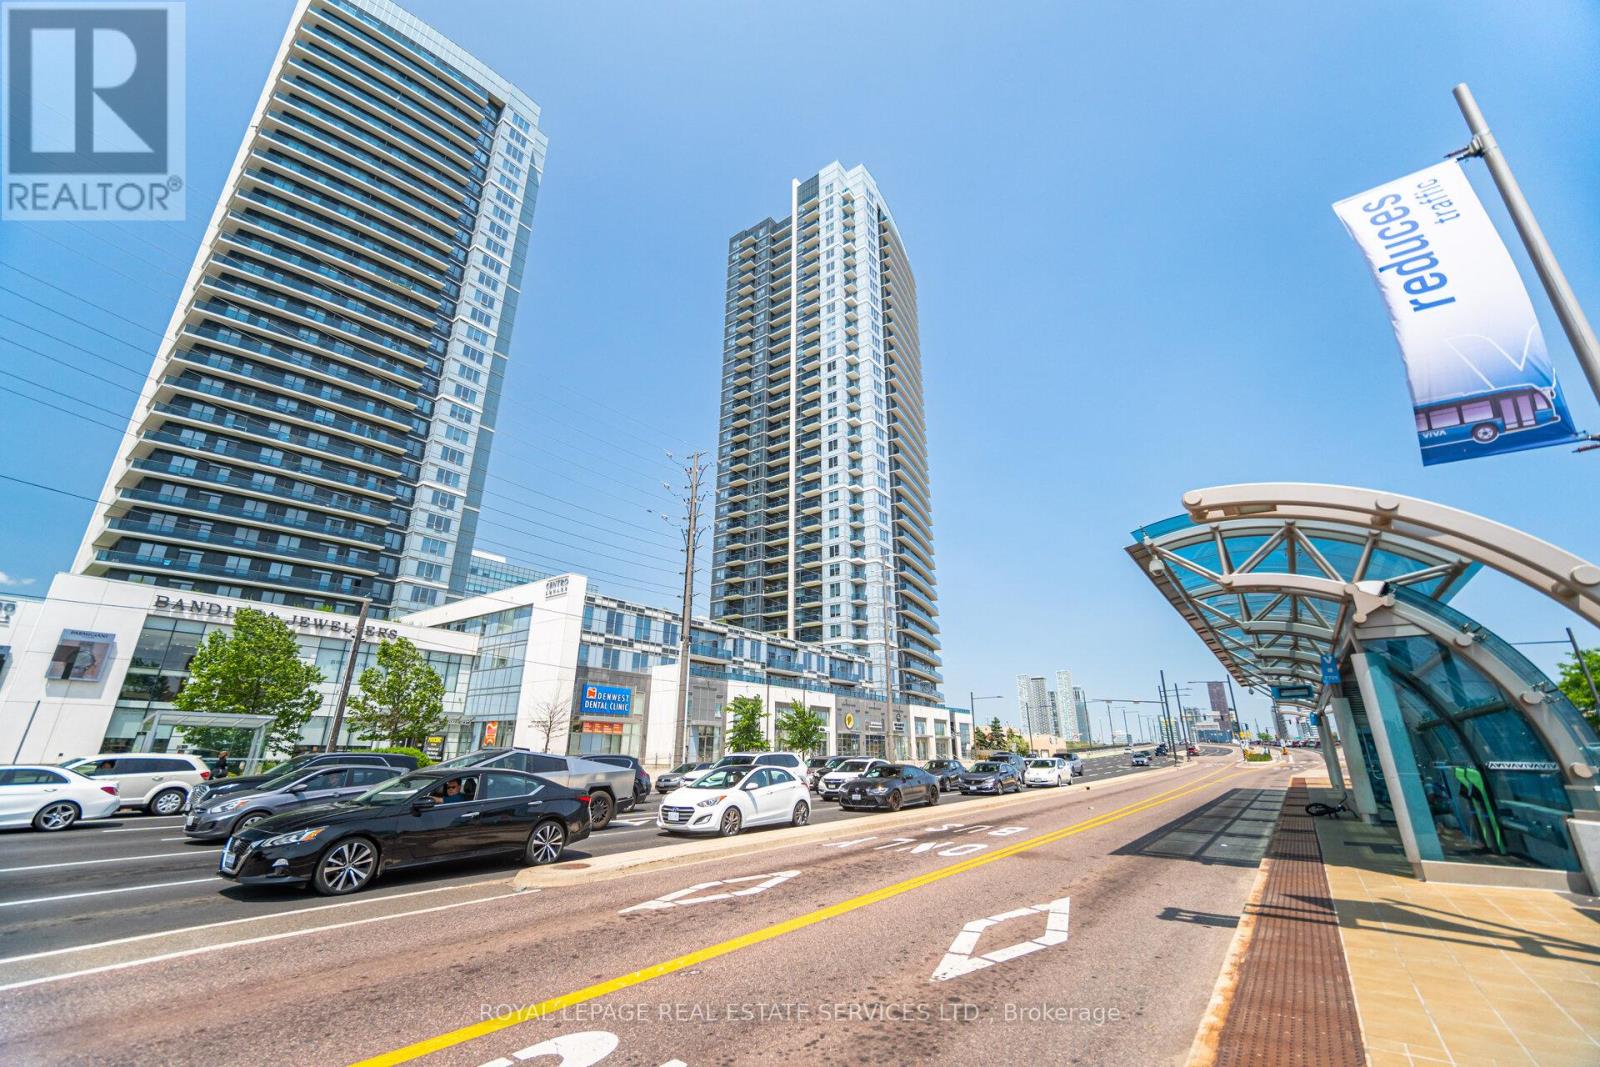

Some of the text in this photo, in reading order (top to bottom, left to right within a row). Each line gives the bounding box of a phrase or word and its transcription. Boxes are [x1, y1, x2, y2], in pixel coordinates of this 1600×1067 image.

[1415, 177, 1461, 225] traffic
[1362, 192, 1456, 313] reduces
[287, 614, 398, 640] JEWELERS
[584, 700, 629, 711] DENTAL CLINIC
[597, 692, 630, 702] DENWEST
